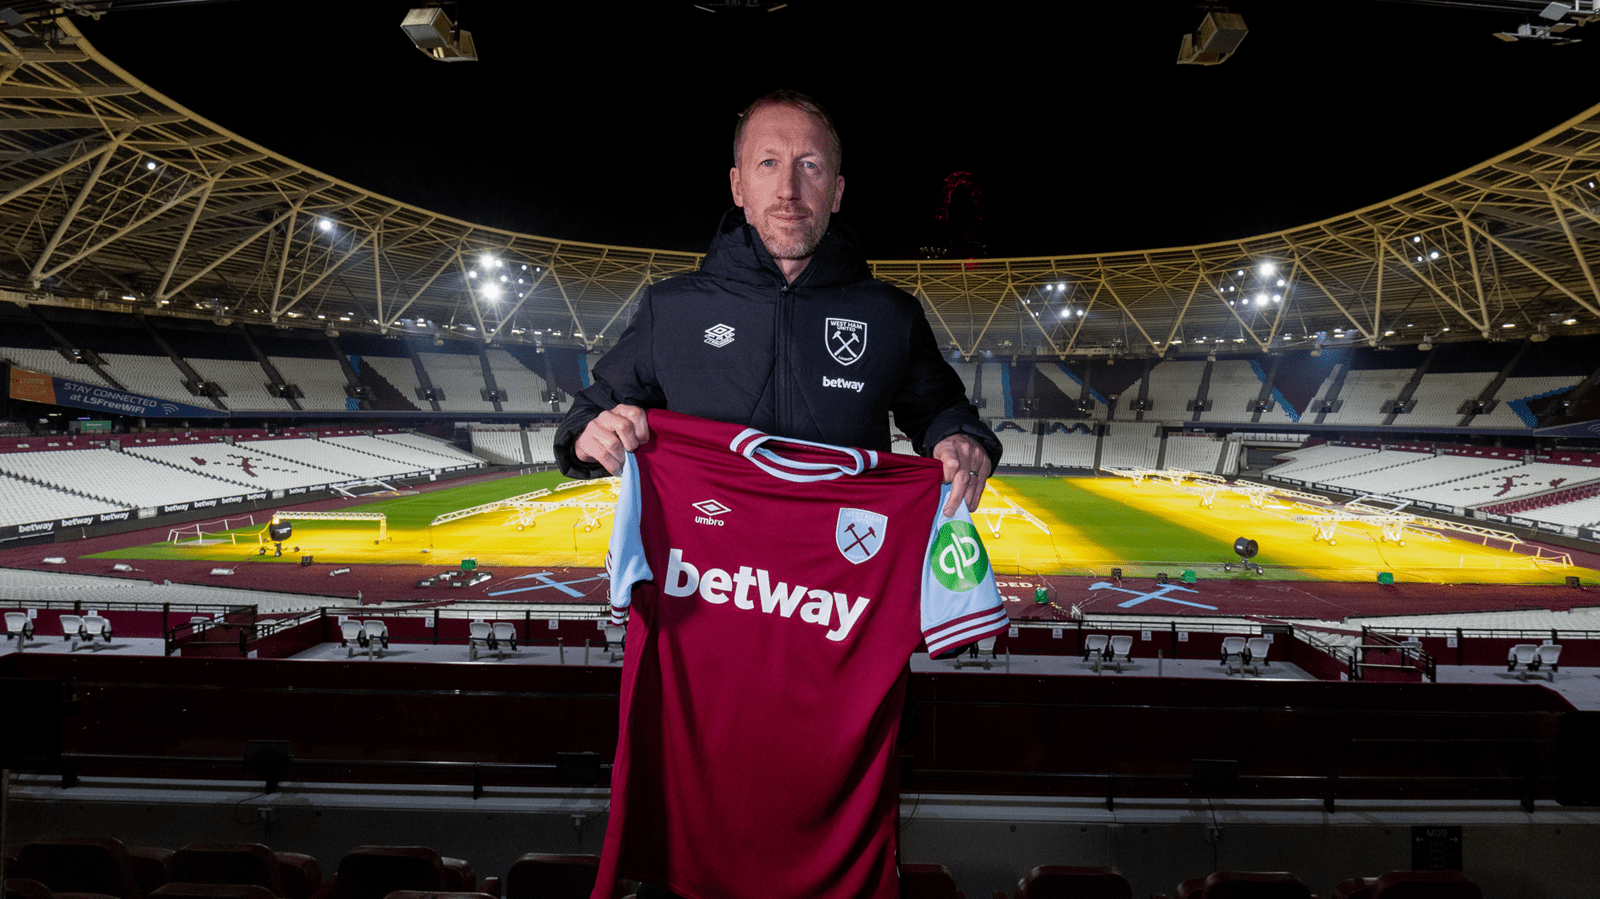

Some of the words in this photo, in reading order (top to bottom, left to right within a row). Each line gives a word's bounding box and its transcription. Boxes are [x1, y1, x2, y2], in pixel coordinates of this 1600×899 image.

[830, 320, 847, 328] WEST
[847, 321, 863, 331] HAM
[822, 376, 865, 393] betway
[63, 382, 92, 394] STAY
[93, 388, 158, 408] CONNECTED
[221, 495, 243, 504] betway
[247, 492, 267, 500] betway
[164, 503, 189, 512] betway
[194, 499, 217, 508] betway
[61, 516, 94, 527] betway
[100, 512, 130, 521] betway
[694, 515, 725, 527] umbro
[845, 510, 862, 519] WEST
[864, 513, 882, 524] HAM
[1486, 512, 1507, 522] betway
[1511, 516, 1534, 527] betway
[18, 522, 54, 533] betway
[1537, 521, 1561, 532] betway
[663, 547, 871, 642] betway
[1426, 829, 1448, 838] M09
